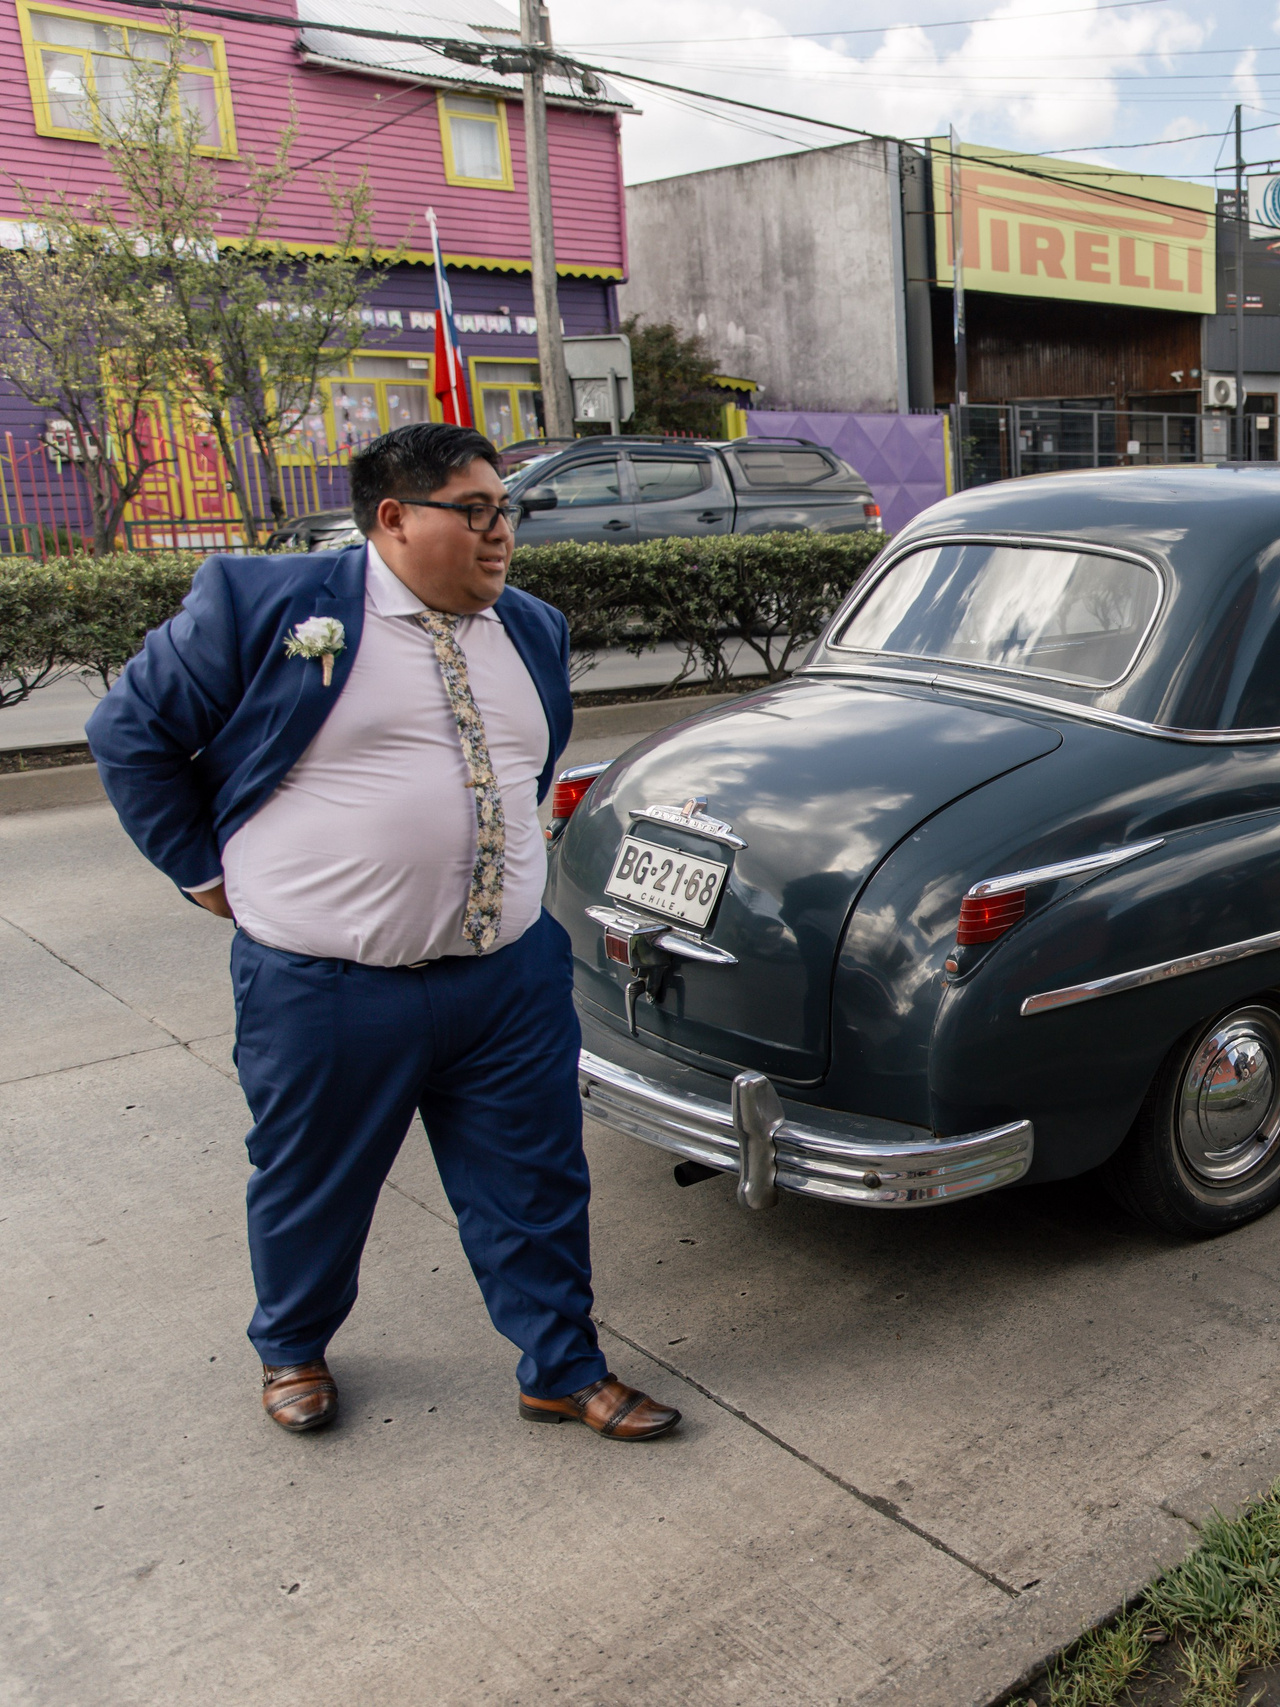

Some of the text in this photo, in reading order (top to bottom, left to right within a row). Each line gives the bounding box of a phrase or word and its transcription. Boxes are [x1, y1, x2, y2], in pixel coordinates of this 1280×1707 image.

[944, 165, 1207, 294] PIRELLI
[653, 811, 718, 834] PLYMOUTH
[641, 893, 676, 910] CHILE
